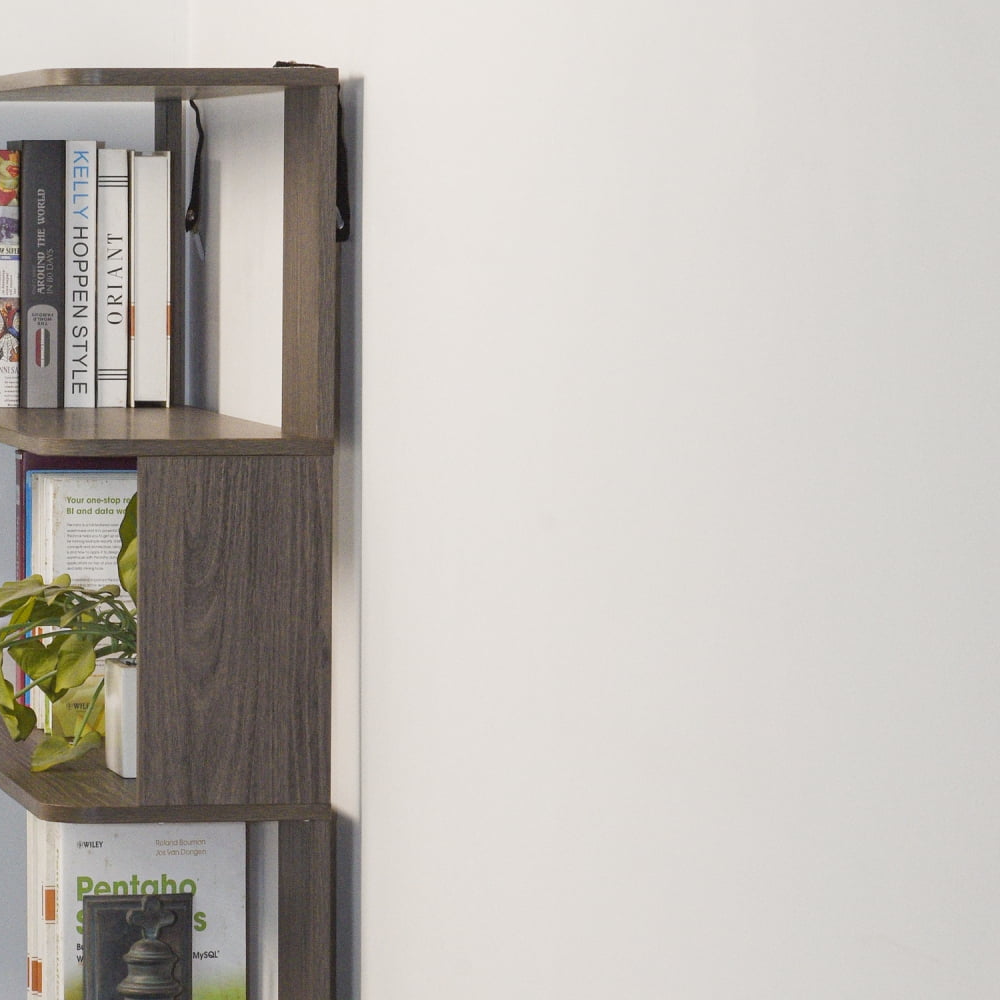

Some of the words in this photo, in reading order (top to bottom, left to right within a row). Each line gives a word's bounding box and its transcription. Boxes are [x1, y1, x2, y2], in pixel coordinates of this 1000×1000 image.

[72, 150, 89, 219] KELLY
[37, 188, 46, 225] WORLD
[37, 228, 46, 248] THE
[37, 252, 46, 295] AROUND
[72, 226, 89, 319] HOPPEN
[107, 233, 123, 325] ORIANT
[72, 325, 88, 395] STYLE
[66, 496, 84, 504] Your
[86, 496, 121, 505] one-stop
[66, 507, 74, 515] BI
[76, 507, 93, 515] and
[94, 507, 114, 515] data
[156, 839, 178, 847] Roland
[77, 873, 197, 900] Pentaho
